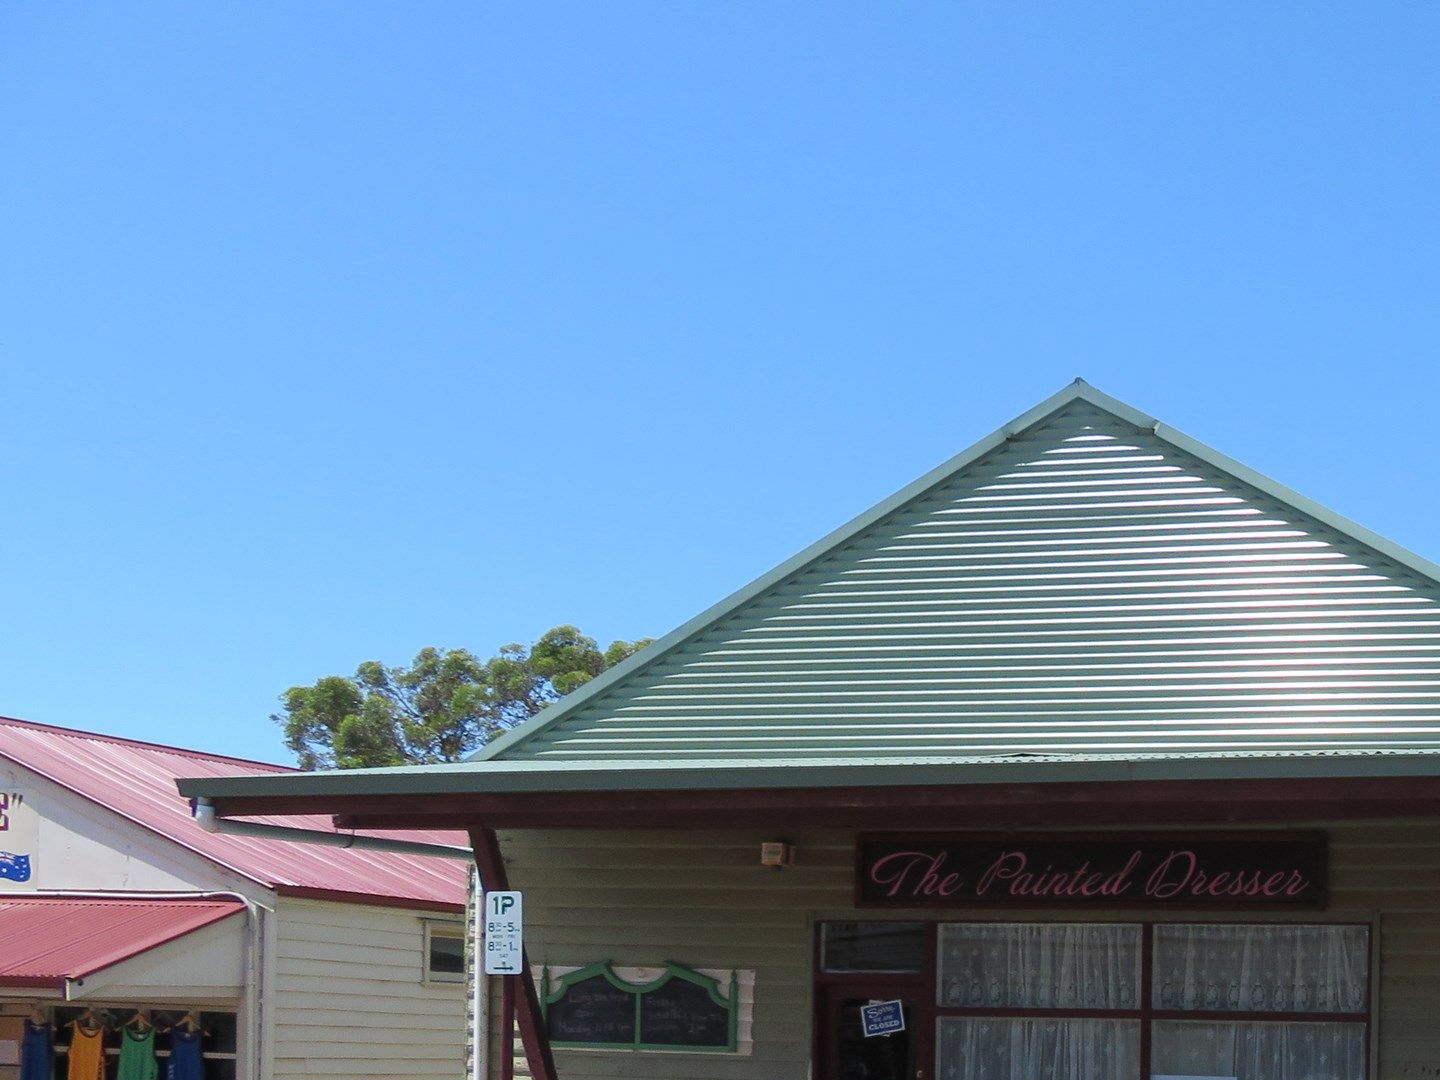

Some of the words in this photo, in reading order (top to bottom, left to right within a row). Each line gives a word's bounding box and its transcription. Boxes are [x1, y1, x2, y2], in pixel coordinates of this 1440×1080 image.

[870, 851, 964, 897] The
[976, 849, 1132, 897] Painted
[1145, 849, 1309, 898] Dresser
[493, 895, 515, 915] 1P
[868, 1020, 900, 1030] CLOSED
